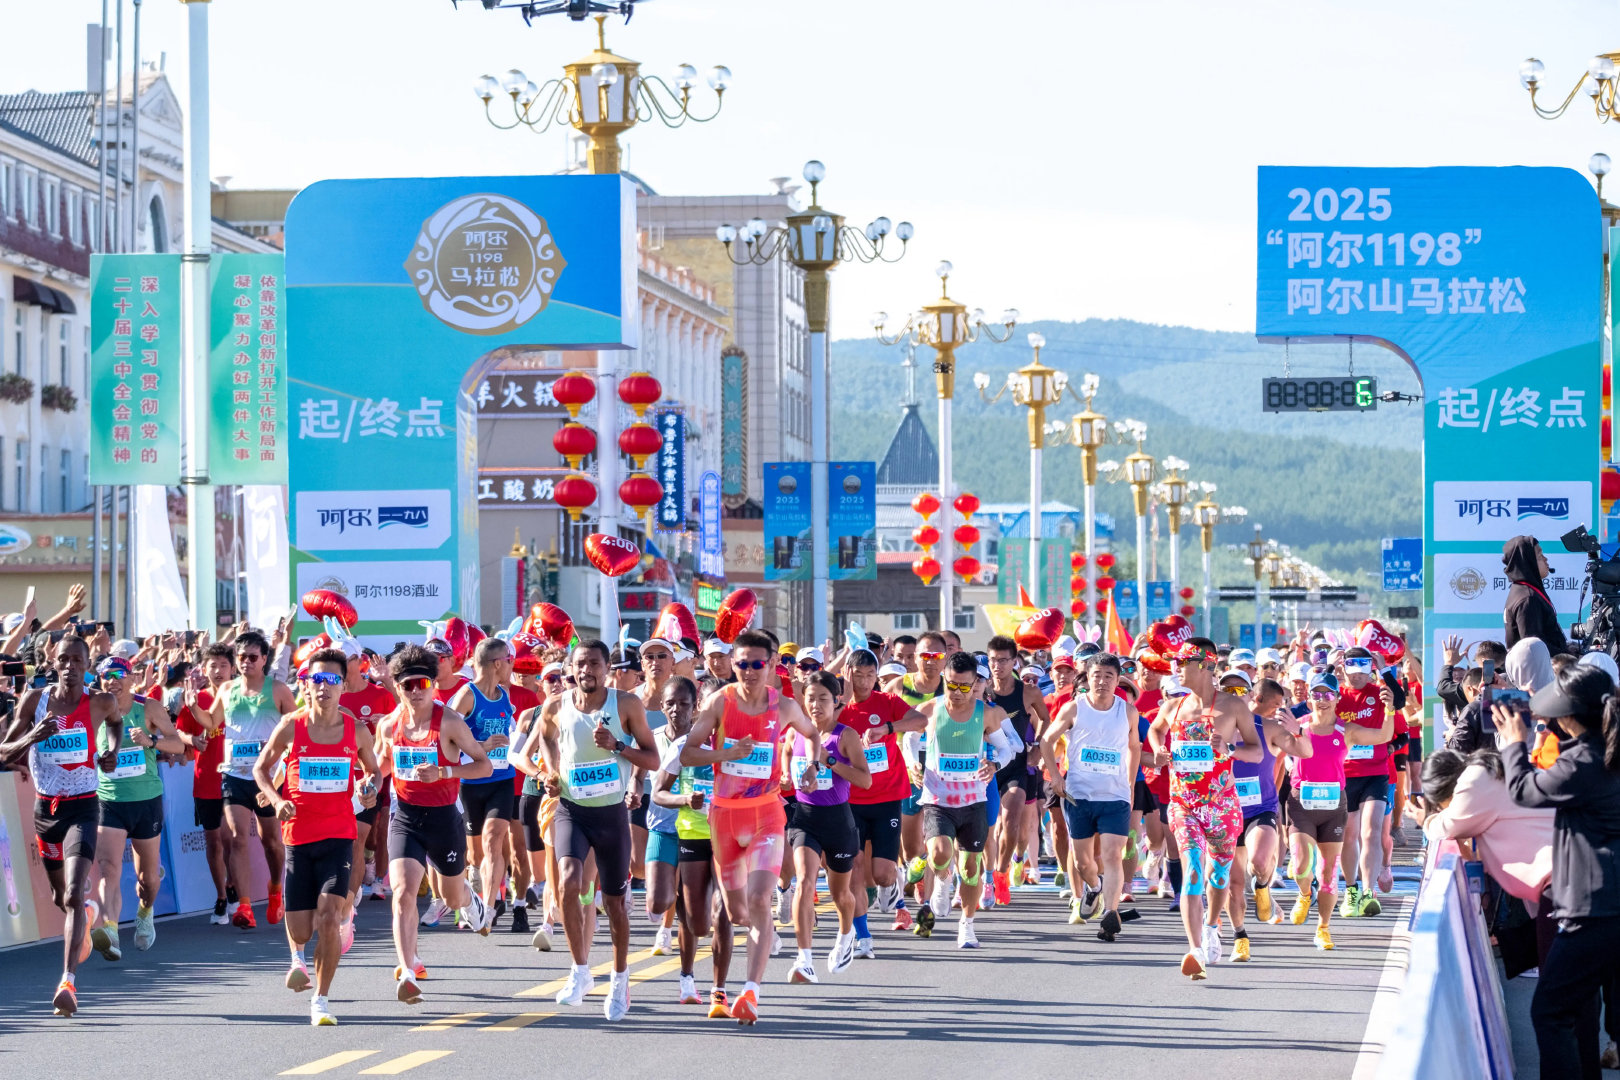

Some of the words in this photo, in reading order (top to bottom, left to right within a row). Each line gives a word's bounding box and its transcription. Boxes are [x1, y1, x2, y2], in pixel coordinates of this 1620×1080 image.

[1287, 187, 1393, 222] 2025
[1266, 228, 1482, 269] “阿尔1198”
[468, 252, 503, 264] 1198
[450, 266, 520, 288] 马拉松
[1287, 277, 1527, 315] 阿尔山马拉松
[114, 277, 131, 463] 二十届三中全会精神
[141, 276, 159, 463] 深入学习贯彻党的
[234, 275, 251, 461] 凝心聚力办好两件大事
[259, 275, 276, 462] 依靠改革创新打开工作新局面
[1437, 386, 1587, 433] 起/终点
[298, 397, 445, 443] 起/终点
[477, 478, 555, 502] 工酸奶
[776, 496, 800, 504] 2025
[840, 496, 865, 504] 2025
[1518, 502, 1567, 512] 一一九八
[378, 509, 428, 521] 一一九八
[600, 536, 634, 553] 4:00
[354, 583, 439, 599] 阿尔1198酒业
[1166, 624, 1192, 646] 5:00
[43, 736, 82, 750] A0008
[236, 745, 259, 755] A041
[748, 751, 769, 763] 力格
[1085, 751, 1116, 763] A0353
[1175, 748, 1207, 759] A0336
[308, 765, 341, 777] 陈柏发
[944, 760, 975, 769] A0315
[573, 767, 614, 783] A0454
